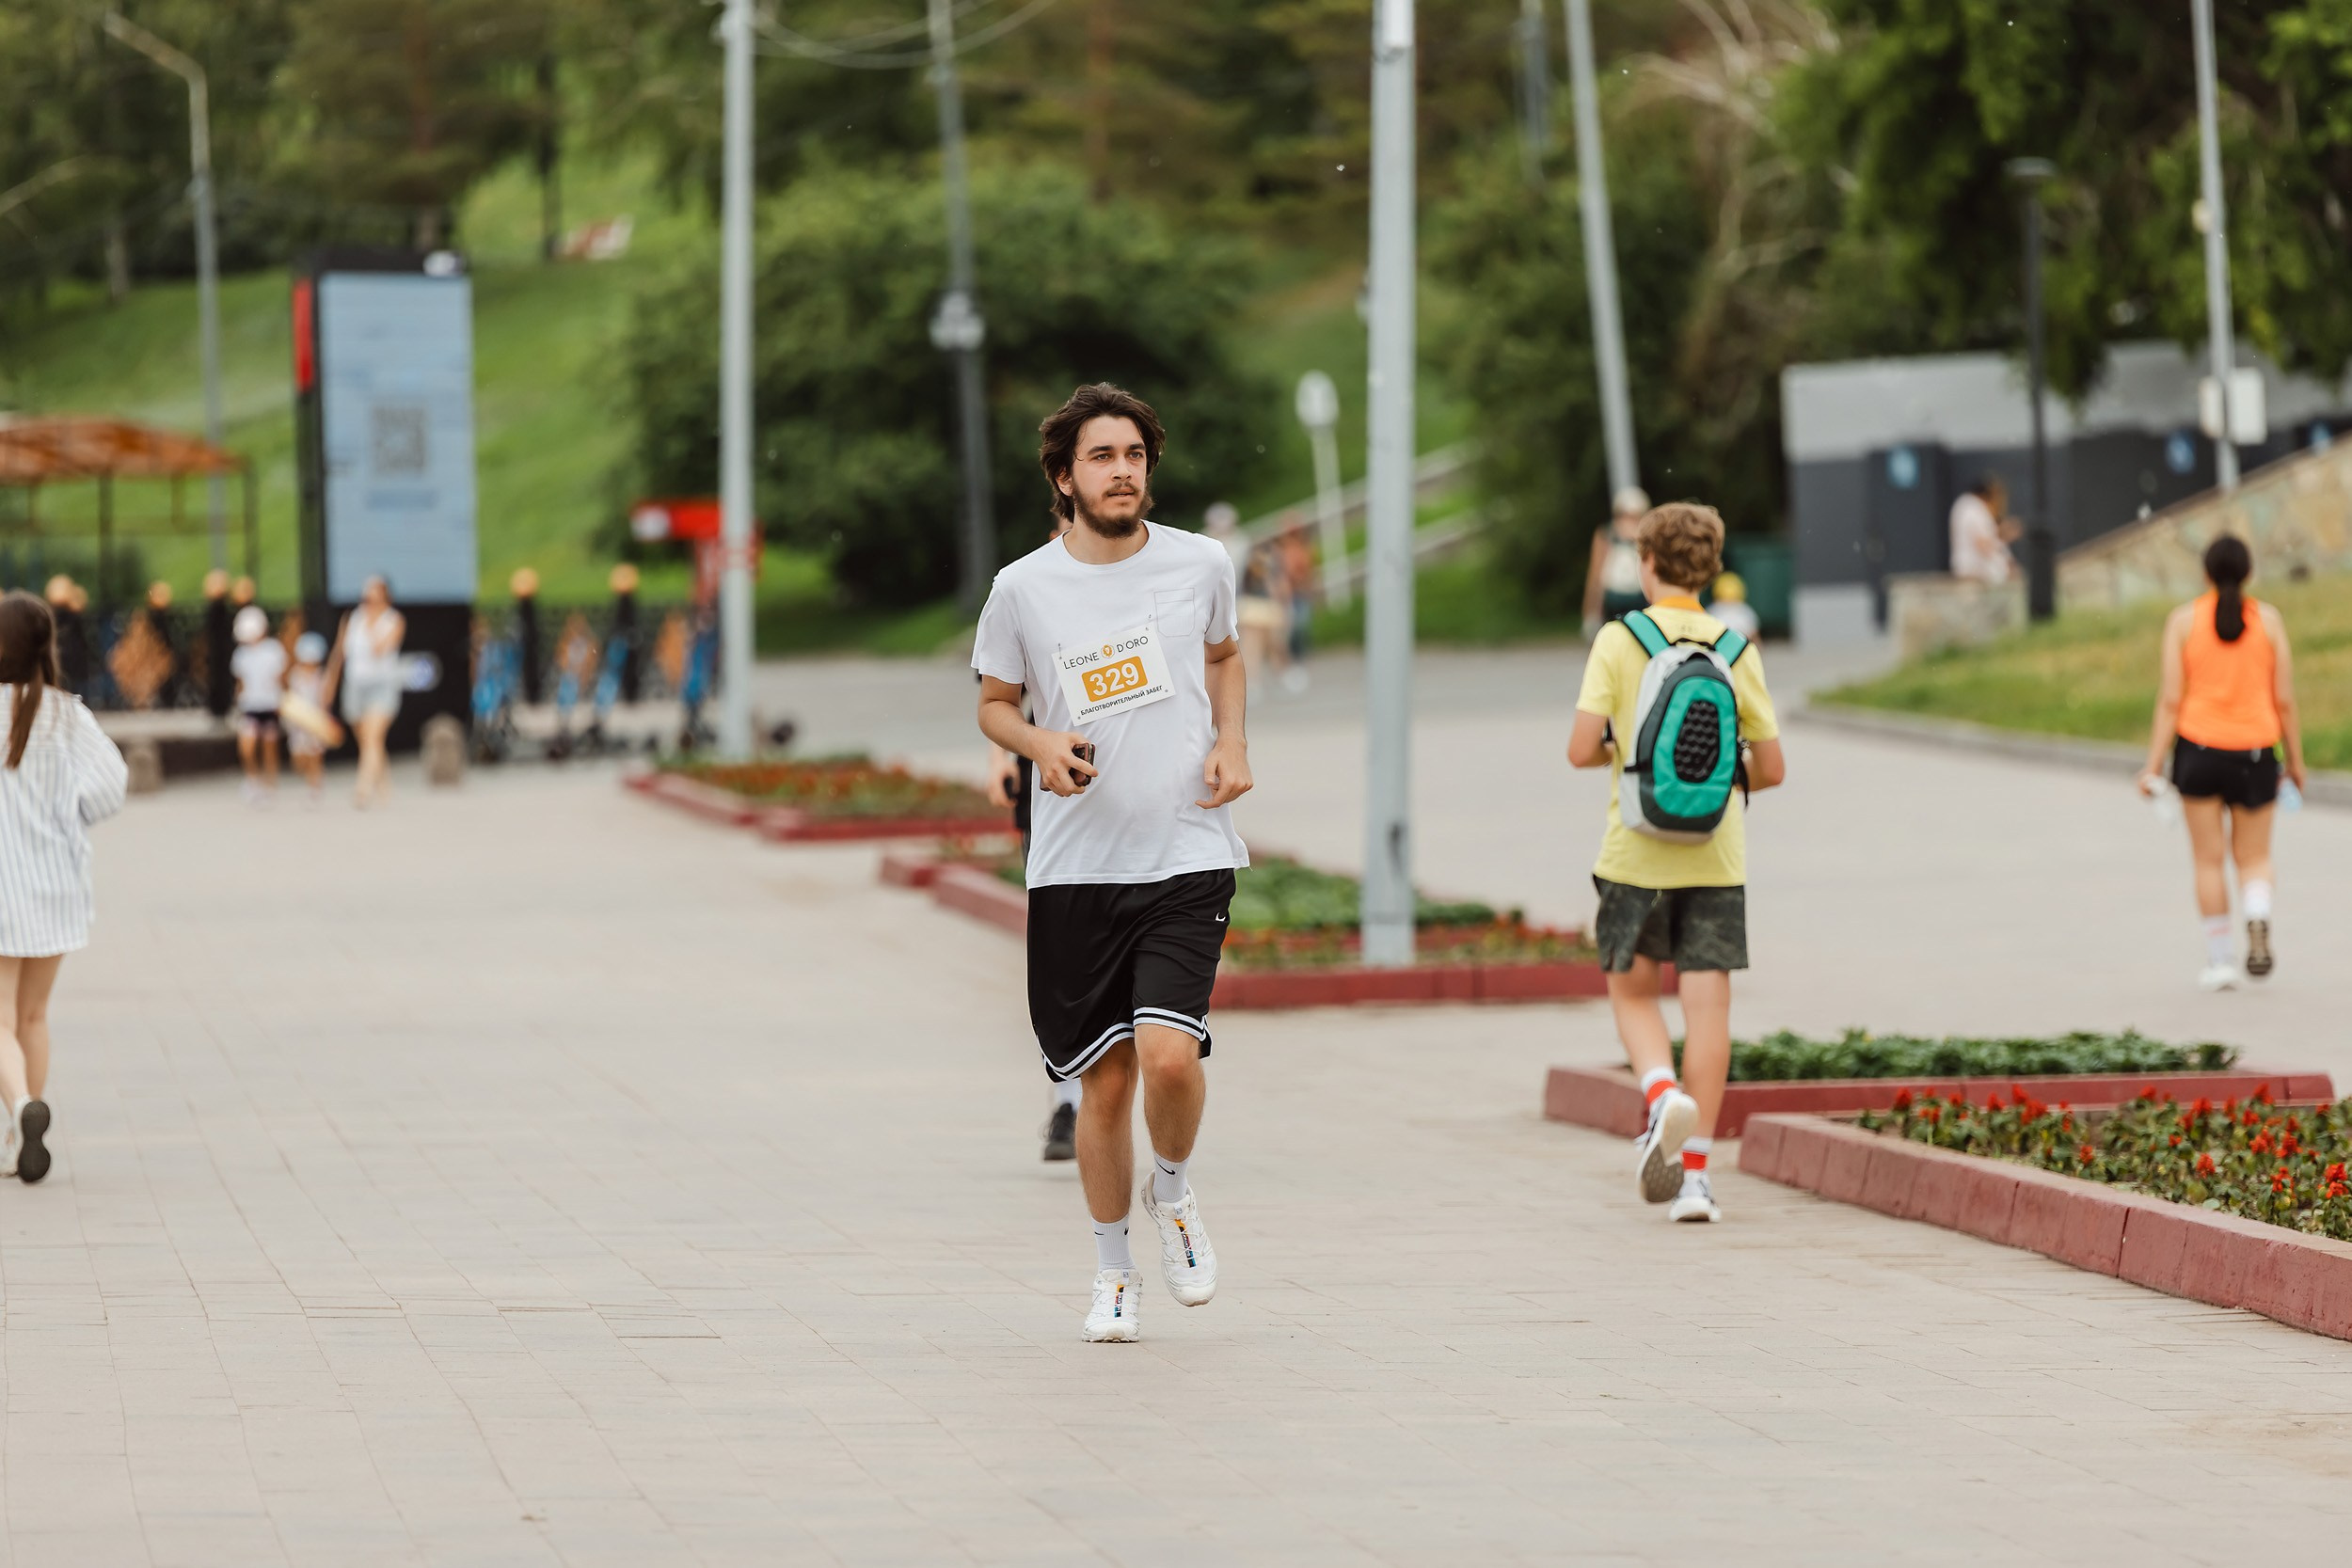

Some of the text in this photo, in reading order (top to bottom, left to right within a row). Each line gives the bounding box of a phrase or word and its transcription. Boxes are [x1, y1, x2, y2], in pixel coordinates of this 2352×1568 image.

[1064, 636, 1148, 669] LEONE D'ORO
[1089, 662, 1139, 696] 329
[1080, 685, 1163, 715] БЛАГОТВОРИТЕЛЬНЫЙ ЗАБЕГ
